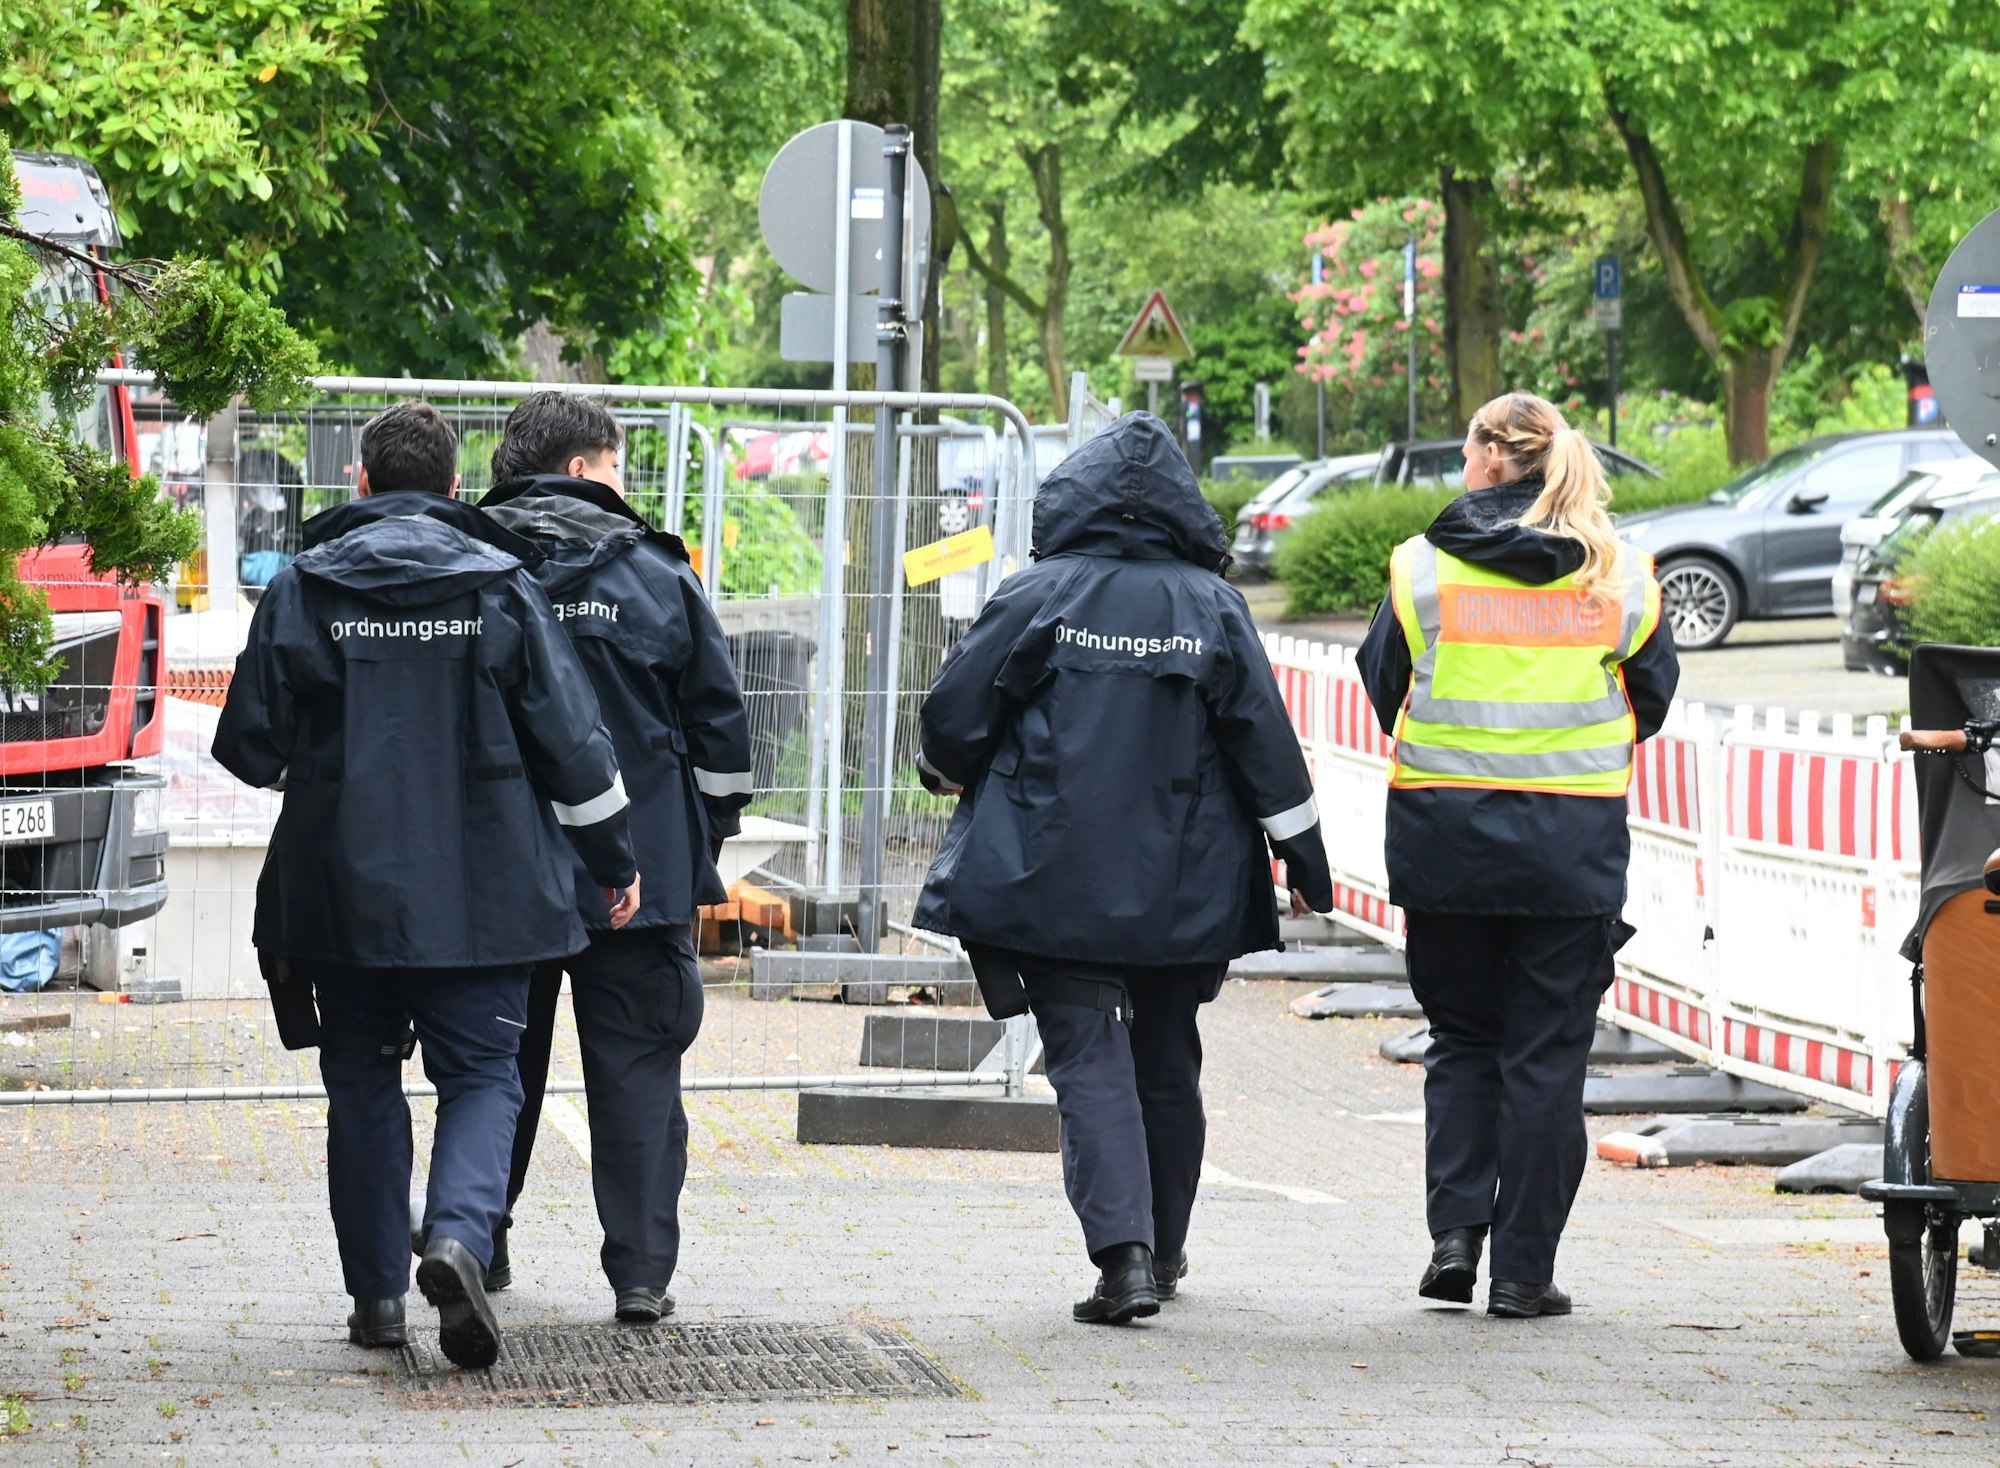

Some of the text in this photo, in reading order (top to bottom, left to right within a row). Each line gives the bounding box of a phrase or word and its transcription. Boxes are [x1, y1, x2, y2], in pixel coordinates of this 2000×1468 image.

[330, 615, 484, 641] Ordnungsamt
[1055, 624, 1203, 657] Ordnungsamt
[17, 805, 46, 834] 268
